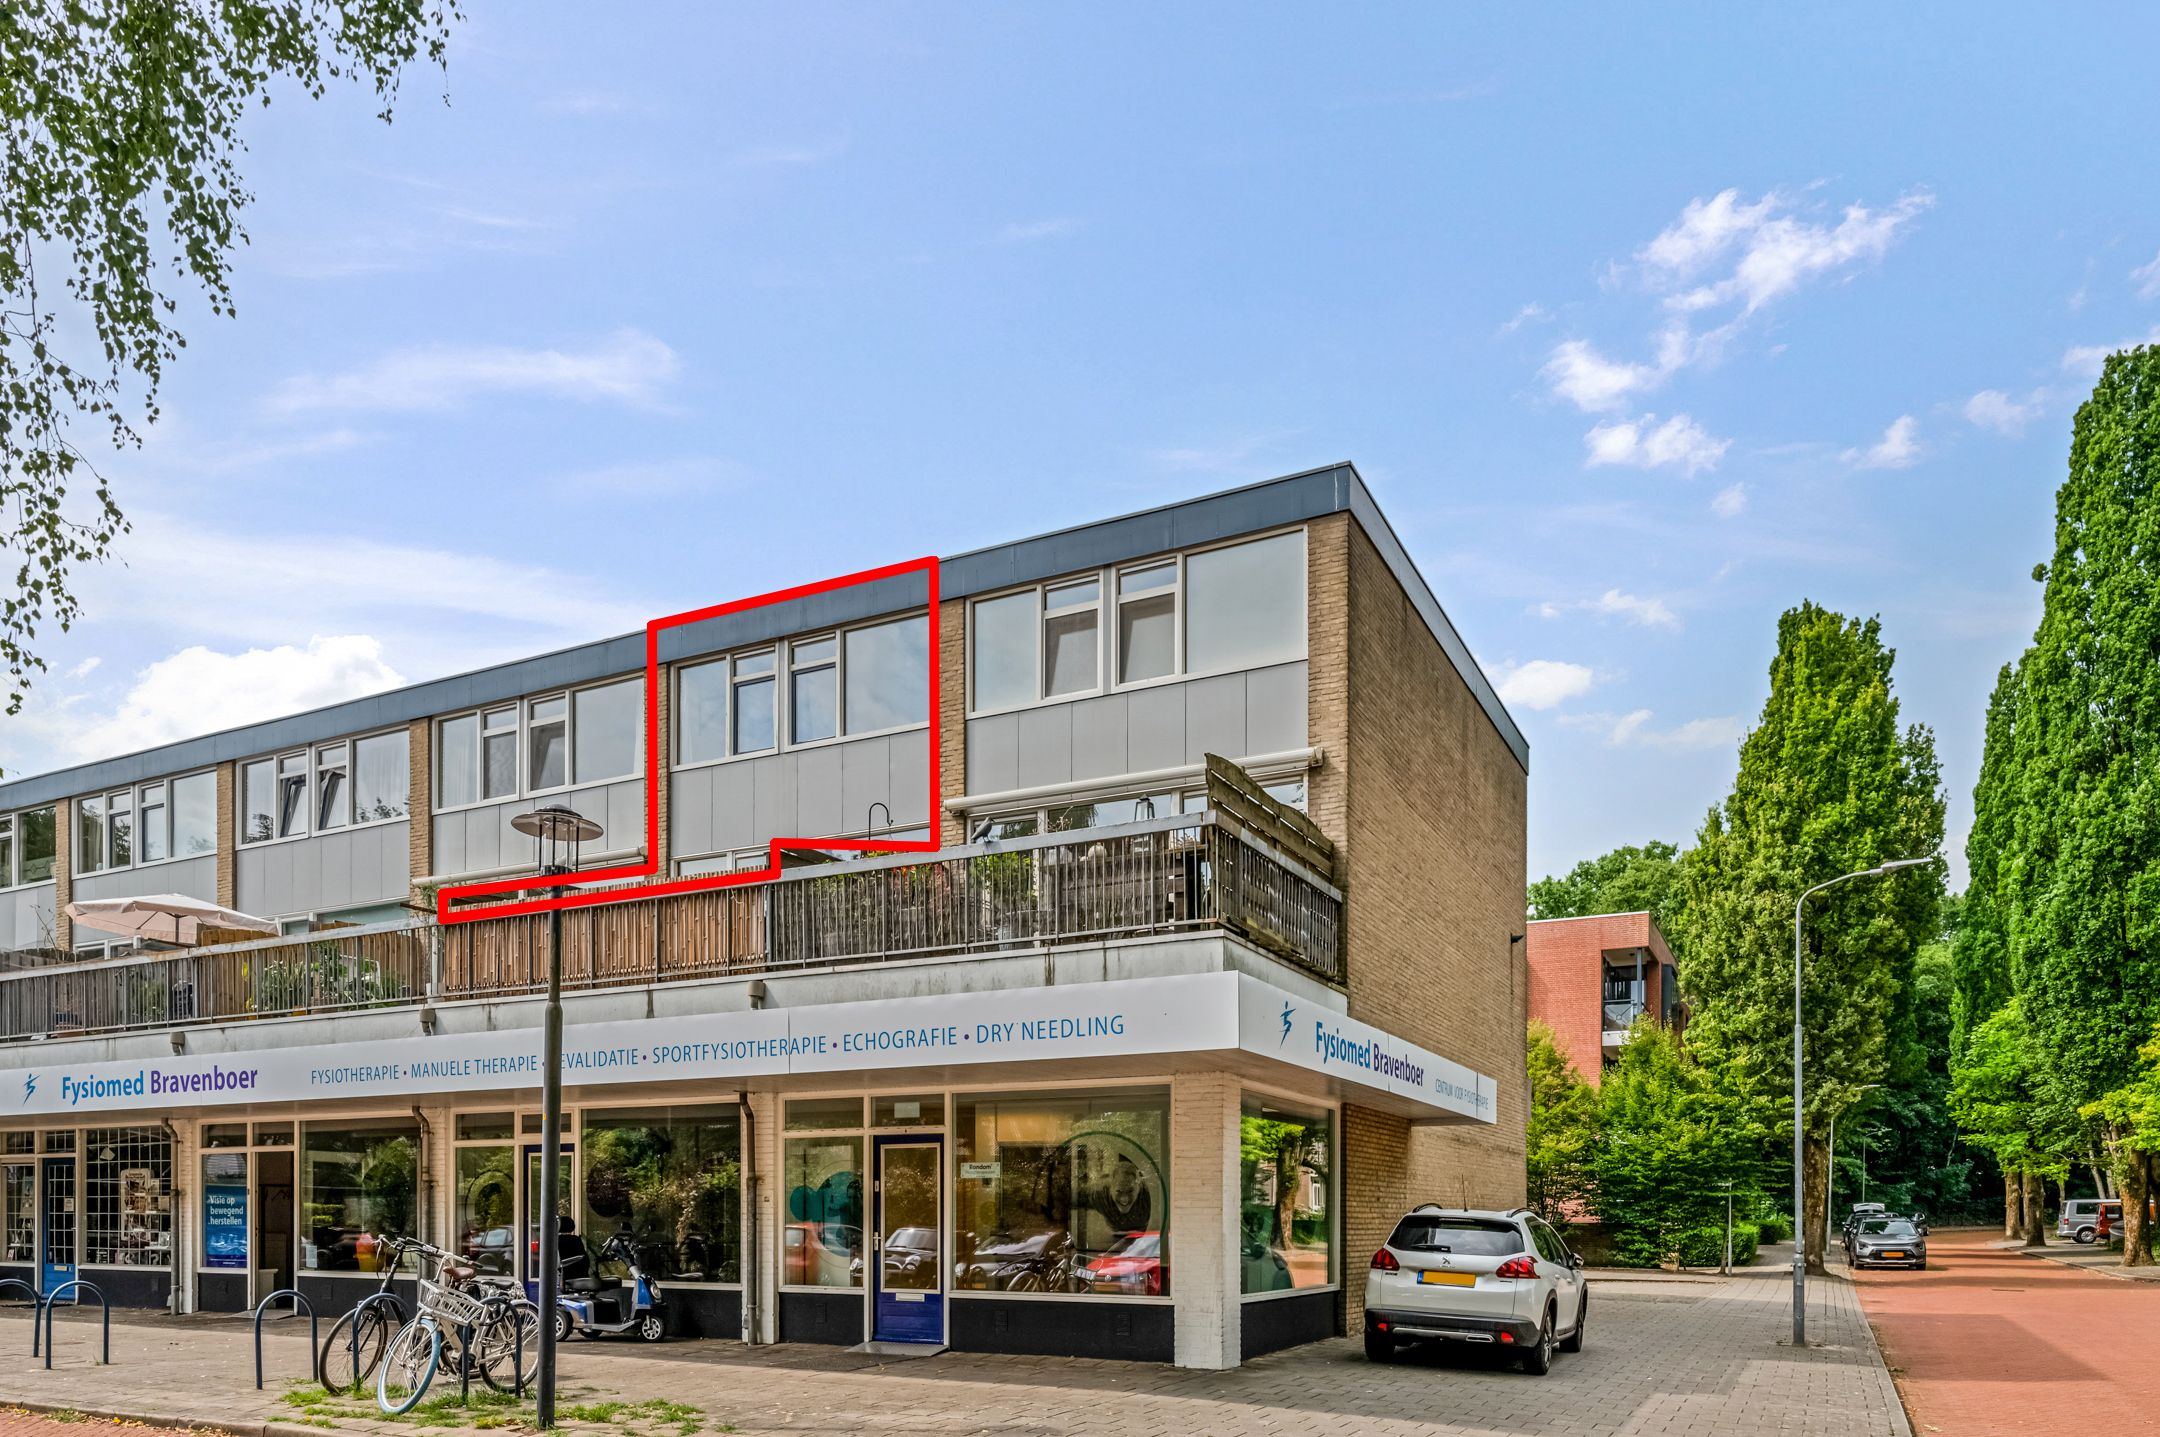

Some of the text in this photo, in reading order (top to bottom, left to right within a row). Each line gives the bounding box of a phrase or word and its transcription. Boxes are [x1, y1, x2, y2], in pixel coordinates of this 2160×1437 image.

[311, 1015, 1125, 1085] FYSIOTHERAPIE MANUELE THERAPIE EVALIDATIE SPORTFYSIOTHERAPIE ECHOGRAFIE DRY NEEDLING
[1315, 1021, 1425, 1087] Fysiomed Bravenboer
[62, 1065, 258, 1106] Fysiomed Bravenboer
[210, 1206, 243, 1216] bewegend
[226, 1197, 236, 1206] op
